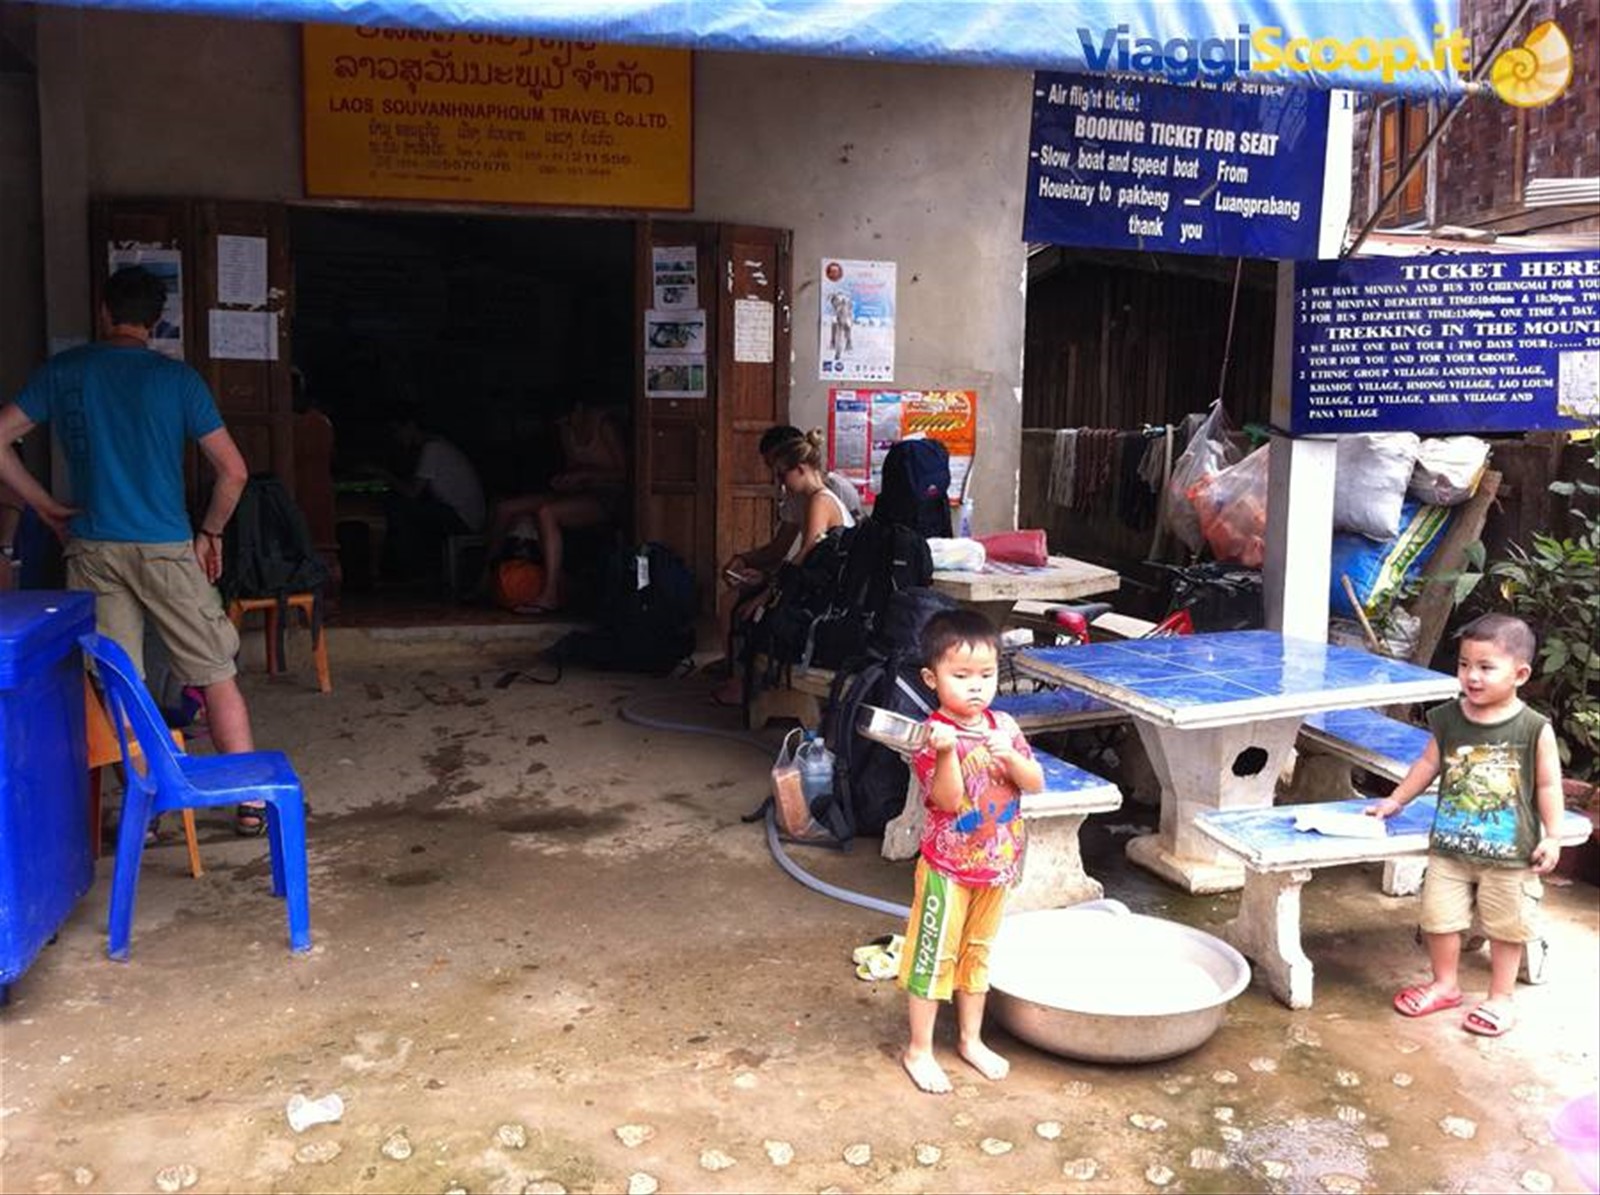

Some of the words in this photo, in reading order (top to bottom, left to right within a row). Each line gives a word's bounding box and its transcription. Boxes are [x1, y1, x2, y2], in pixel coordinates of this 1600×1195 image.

[1048, 84, 1066, 105] Air
[329, 97, 374, 113] LAOS
[382, 98, 545, 121] SOUVANHNAPHOUM
[551, 107, 610, 126] TRAVEL
[1074, 115, 1145, 144] BOOKING
[1150, 122, 1202, 149] TICKET
[1205, 128, 1235, 152] FOR
[1240, 132, 1280, 157] SEAT
[1077, 147, 1104, 170] boat
[1107, 150, 1130, 173] and
[1131, 154, 1167, 182] speed
[1173, 156, 1199, 179] boat
[1216, 160, 1249, 183] From
[1038, 176, 1095, 207] Houeixay
[1099, 180, 1112, 202] to
[1117, 183, 1170, 212] pakbeng
[1214, 191, 1301, 221] Luangprabang
[1128, 215, 1163, 237] thank
[1180, 222, 1203, 243] you
[1401, 262, 1508, 281] TICKET
[1520, 260, 1600, 278] HERE
[1311, 286, 1328, 297] WE
[1332, 285, 1359, 297] HAVE
[1363, 284, 1409, 296] MINIVAN
[1415, 283, 1438, 294] AND
[1442, 282, 1463, 293] BUS
[1469, 281, 1484, 292] TO
[1551, 278, 1574, 290] FOR
[1311, 299, 1332, 310] FOR
[1384, 296, 1444, 308] DEPARTURE
[1582, 291, 1600, 303] TW
[1310, 312, 1331, 323] FOR
[1336, 312, 1357, 323] BUS
[1362, 309, 1422, 321] DEPARTURE
[1500, 307, 1524, 318] ONE
[1528, 306, 1556, 318] TIME
[1559, 306, 1568, 317] A
[1572, 305, 1597, 316] DAY.
[1325, 323, 1433, 341] TREKKING
[1440, 322, 1464, 337] IN
[1473, 321, 1518, 336] THE
[1310, 343, 1327, 353] WE
[1331, 342, 1359, 353] HAVE
[1363, 341, 1385, 352] ONE
[1390, 341, 1411, 351] DAY
[1416, 340, 1444, 351] TOUR
[1458, 340, 1482, 350] TWO
[1487, 339, 1513, 350] DAYS
[1309, 357, 1337, 367] TOUR
[1340, 356, 1360, 366] FOR
[1365, 355, 1387, 365] YOU
[1393, 354, 1415, 364] AND
[1419, 354, 1441, 364] FOR
[1445, 353, 1475, 363] YOUR
[1310, 369, 1350, 380] ETHNIC
[1353, 368, 1390, 379] GROUP
[1498, 378, 1520, 388] LAO
[1522, 377, 1554, 388] LOUM
[1463, 392, 1507, 403] VILLAGE
[1510, 391, 1535, 402] AND
[1308, 409, 1335, 420] PANA
[1338, 408, 1380, 419] VILLAGE
